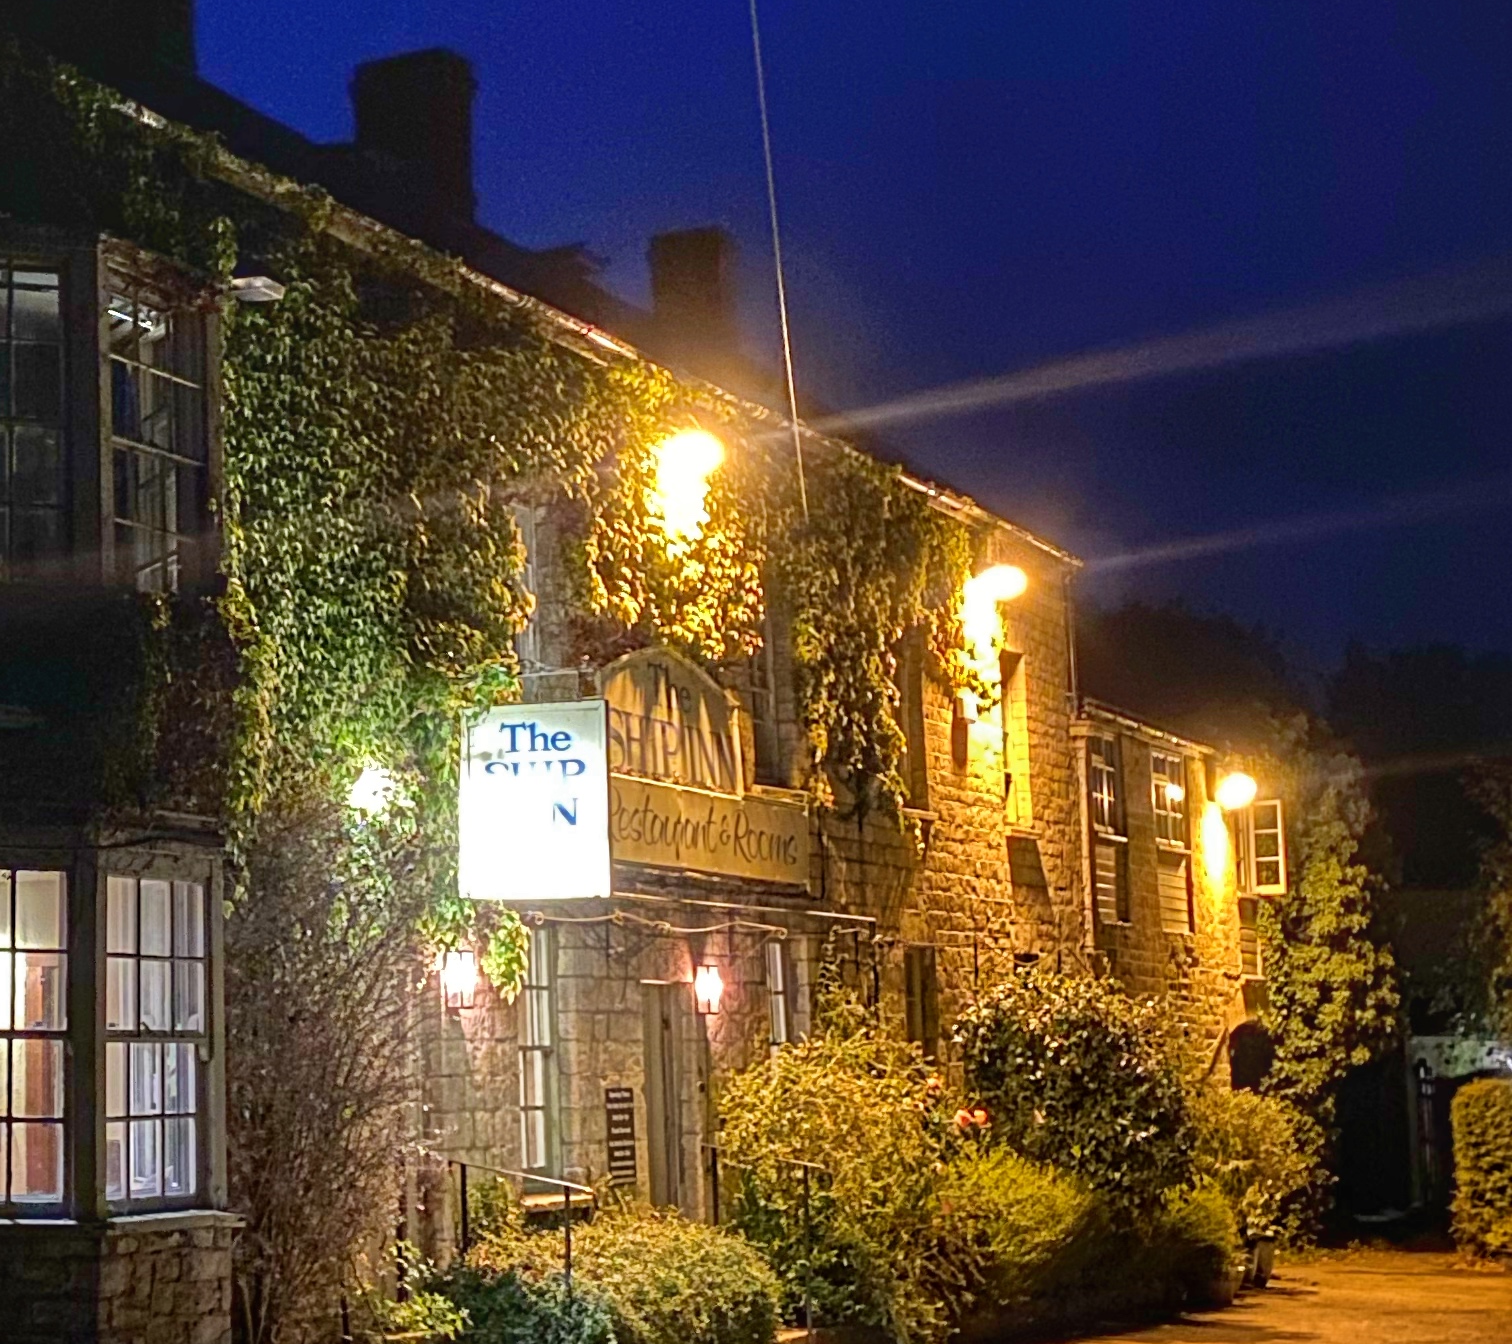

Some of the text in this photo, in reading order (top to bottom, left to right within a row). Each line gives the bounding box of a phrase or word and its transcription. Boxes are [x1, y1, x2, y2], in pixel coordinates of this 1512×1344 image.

[647, 661, 691, 713] The
[498, 721, 572, 754] The
[609, 707, 738, 795] SHIP INN
[610, 786, 717, 860] Restaurant
[734, 809, 798, 866] Rooms
